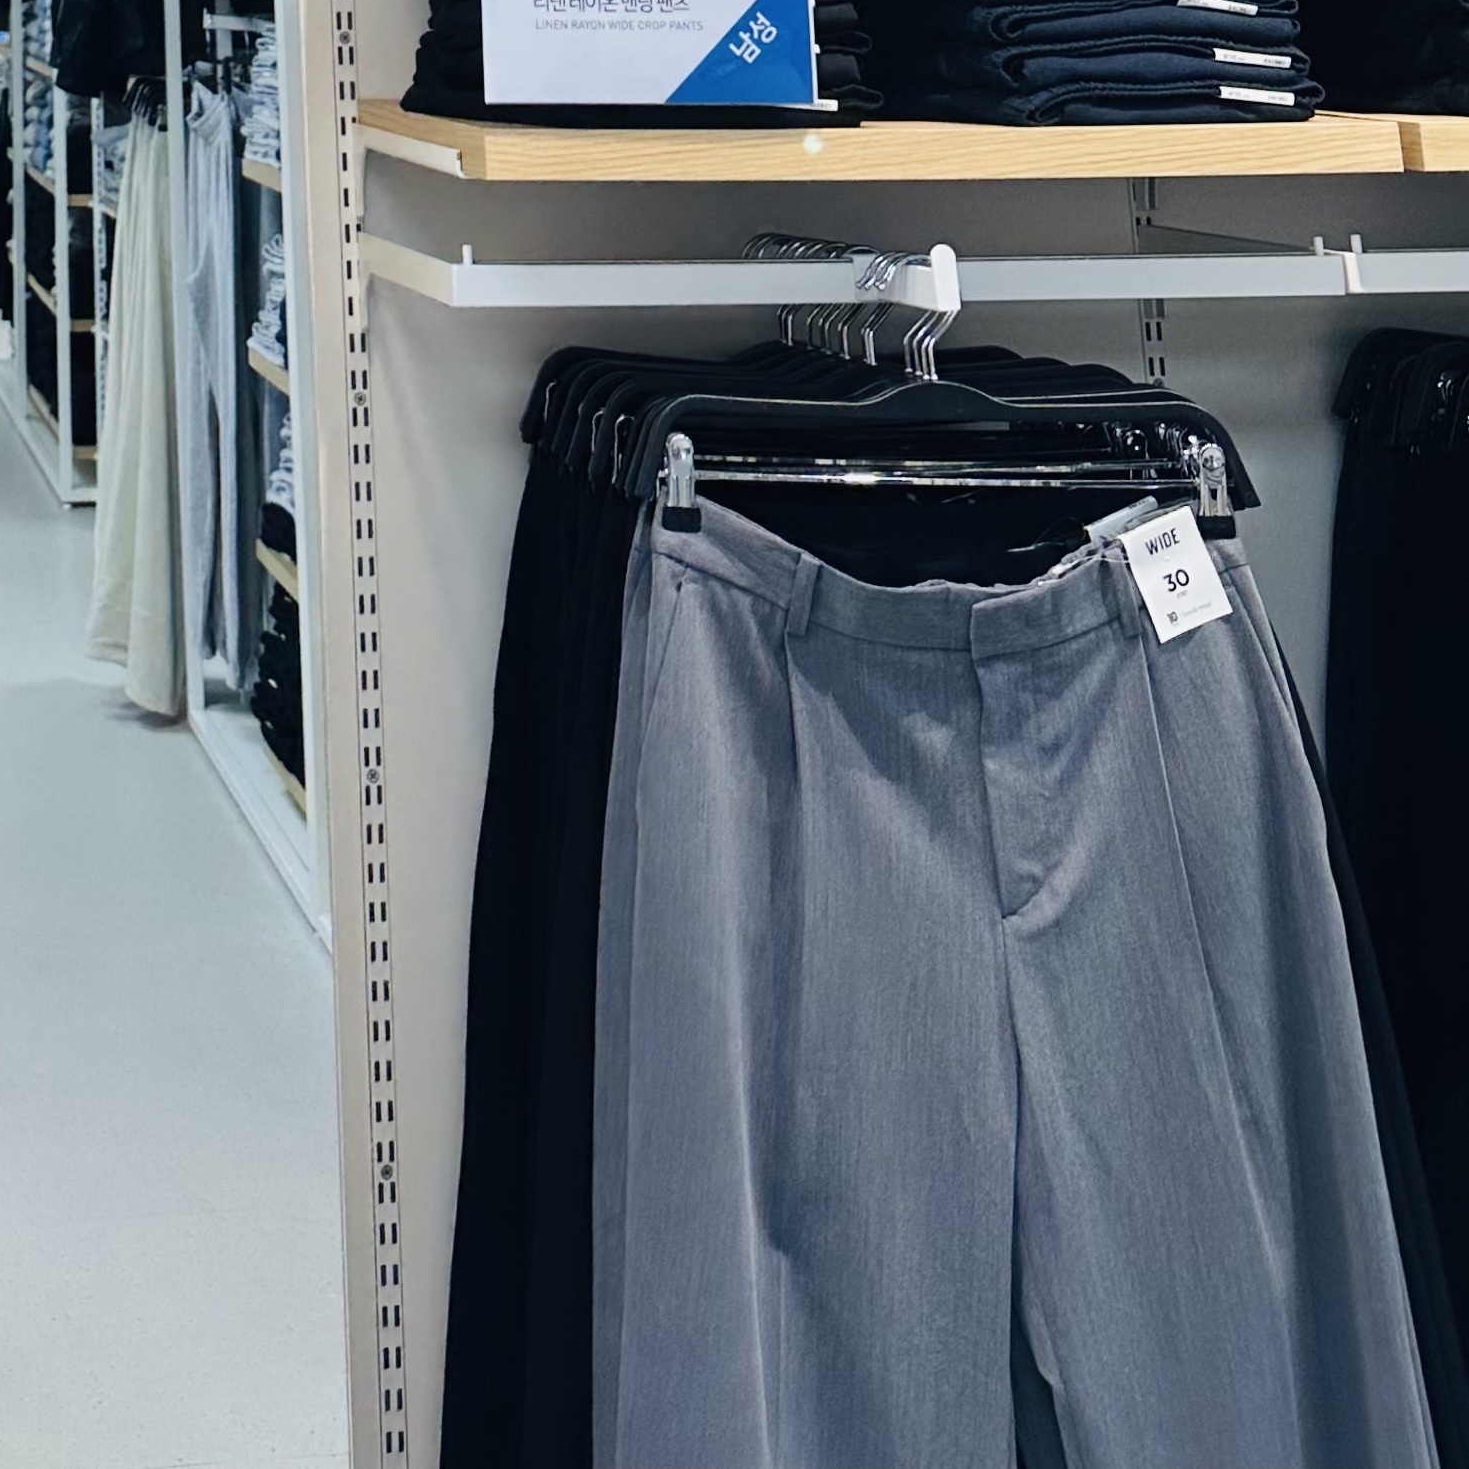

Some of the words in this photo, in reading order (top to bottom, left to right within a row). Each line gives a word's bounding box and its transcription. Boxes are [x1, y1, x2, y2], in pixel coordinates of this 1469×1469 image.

[535, 19, 568, 30] LINEN
[571, 20, 606, 30] RAYON
[608, 20, 635, 31] WIDE
[669, 21, 704, 31] PANTS
[728, 11, 778, 64] 남성
[1144, 527, 1181, 556] WIDE
[1162, 568, 1190, 592] 30
